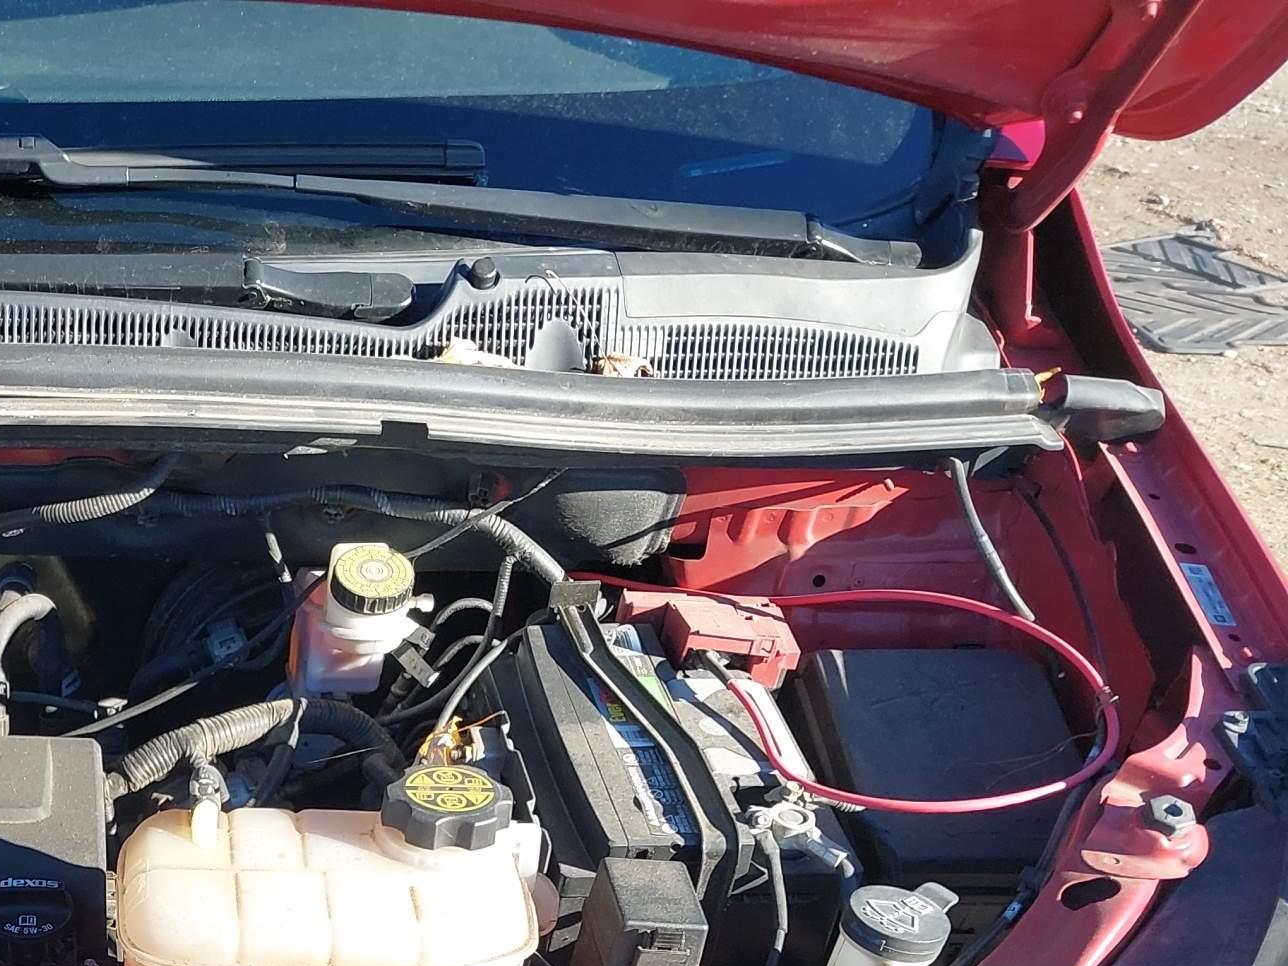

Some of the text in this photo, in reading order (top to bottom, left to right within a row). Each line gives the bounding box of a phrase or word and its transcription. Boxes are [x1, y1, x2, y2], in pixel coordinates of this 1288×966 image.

[0, 877, 59, 889] dexos
[3, 923, 54, 935] SAE 5W-30
